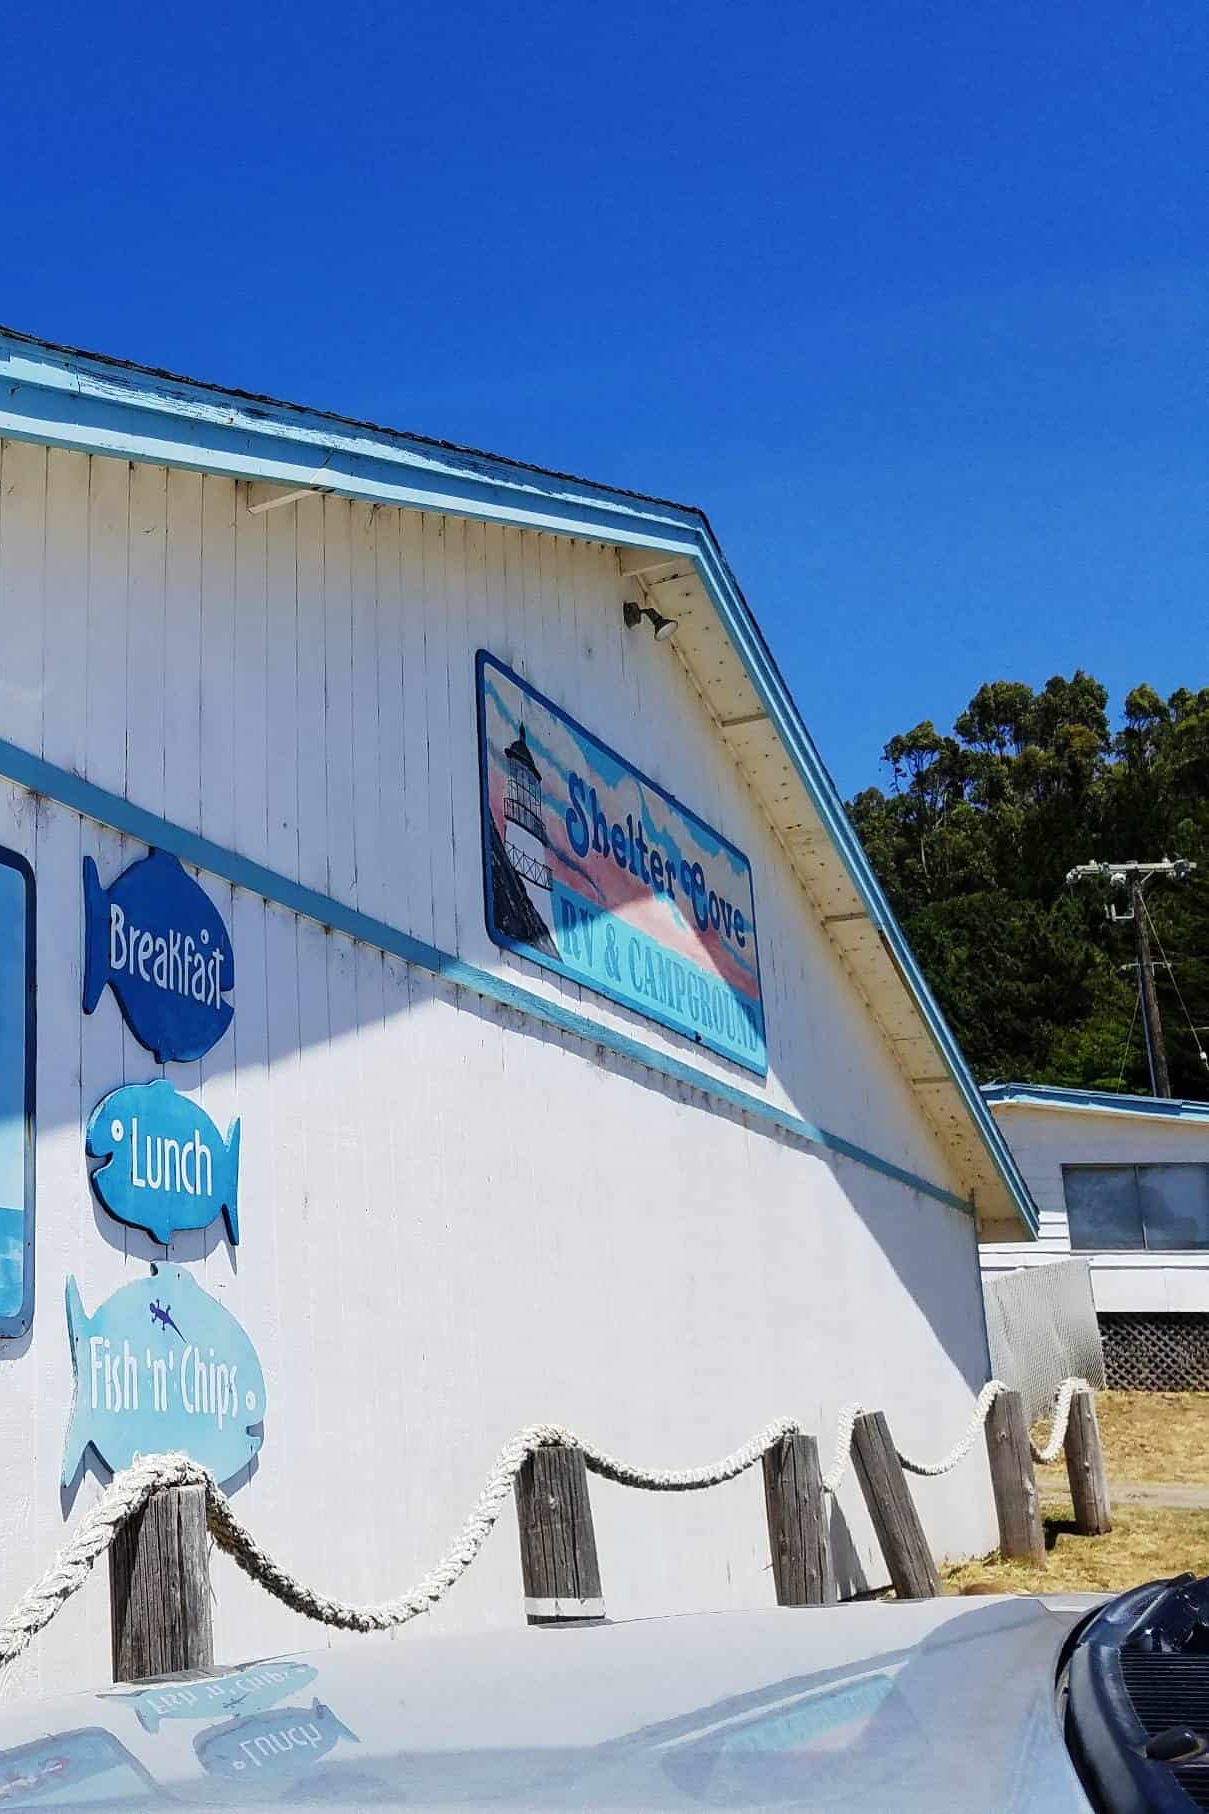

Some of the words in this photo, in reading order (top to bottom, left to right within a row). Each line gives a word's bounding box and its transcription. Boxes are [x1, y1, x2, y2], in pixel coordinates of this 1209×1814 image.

[565, 772, 678, 900] Shelter
[678, 858, 747, 949] Cove
[109, 903, 224, 1010] Breakfast
[558, 894, 594, 970] RV
[604, 921, 621, 983] &
[629, 935, 759, 1055] CAMPGROUND
[131, 1117, 212, 1196] Lunch
[90, 1336, 139, 1413] Fish
[180, 1345, 239, 1431] Chips
